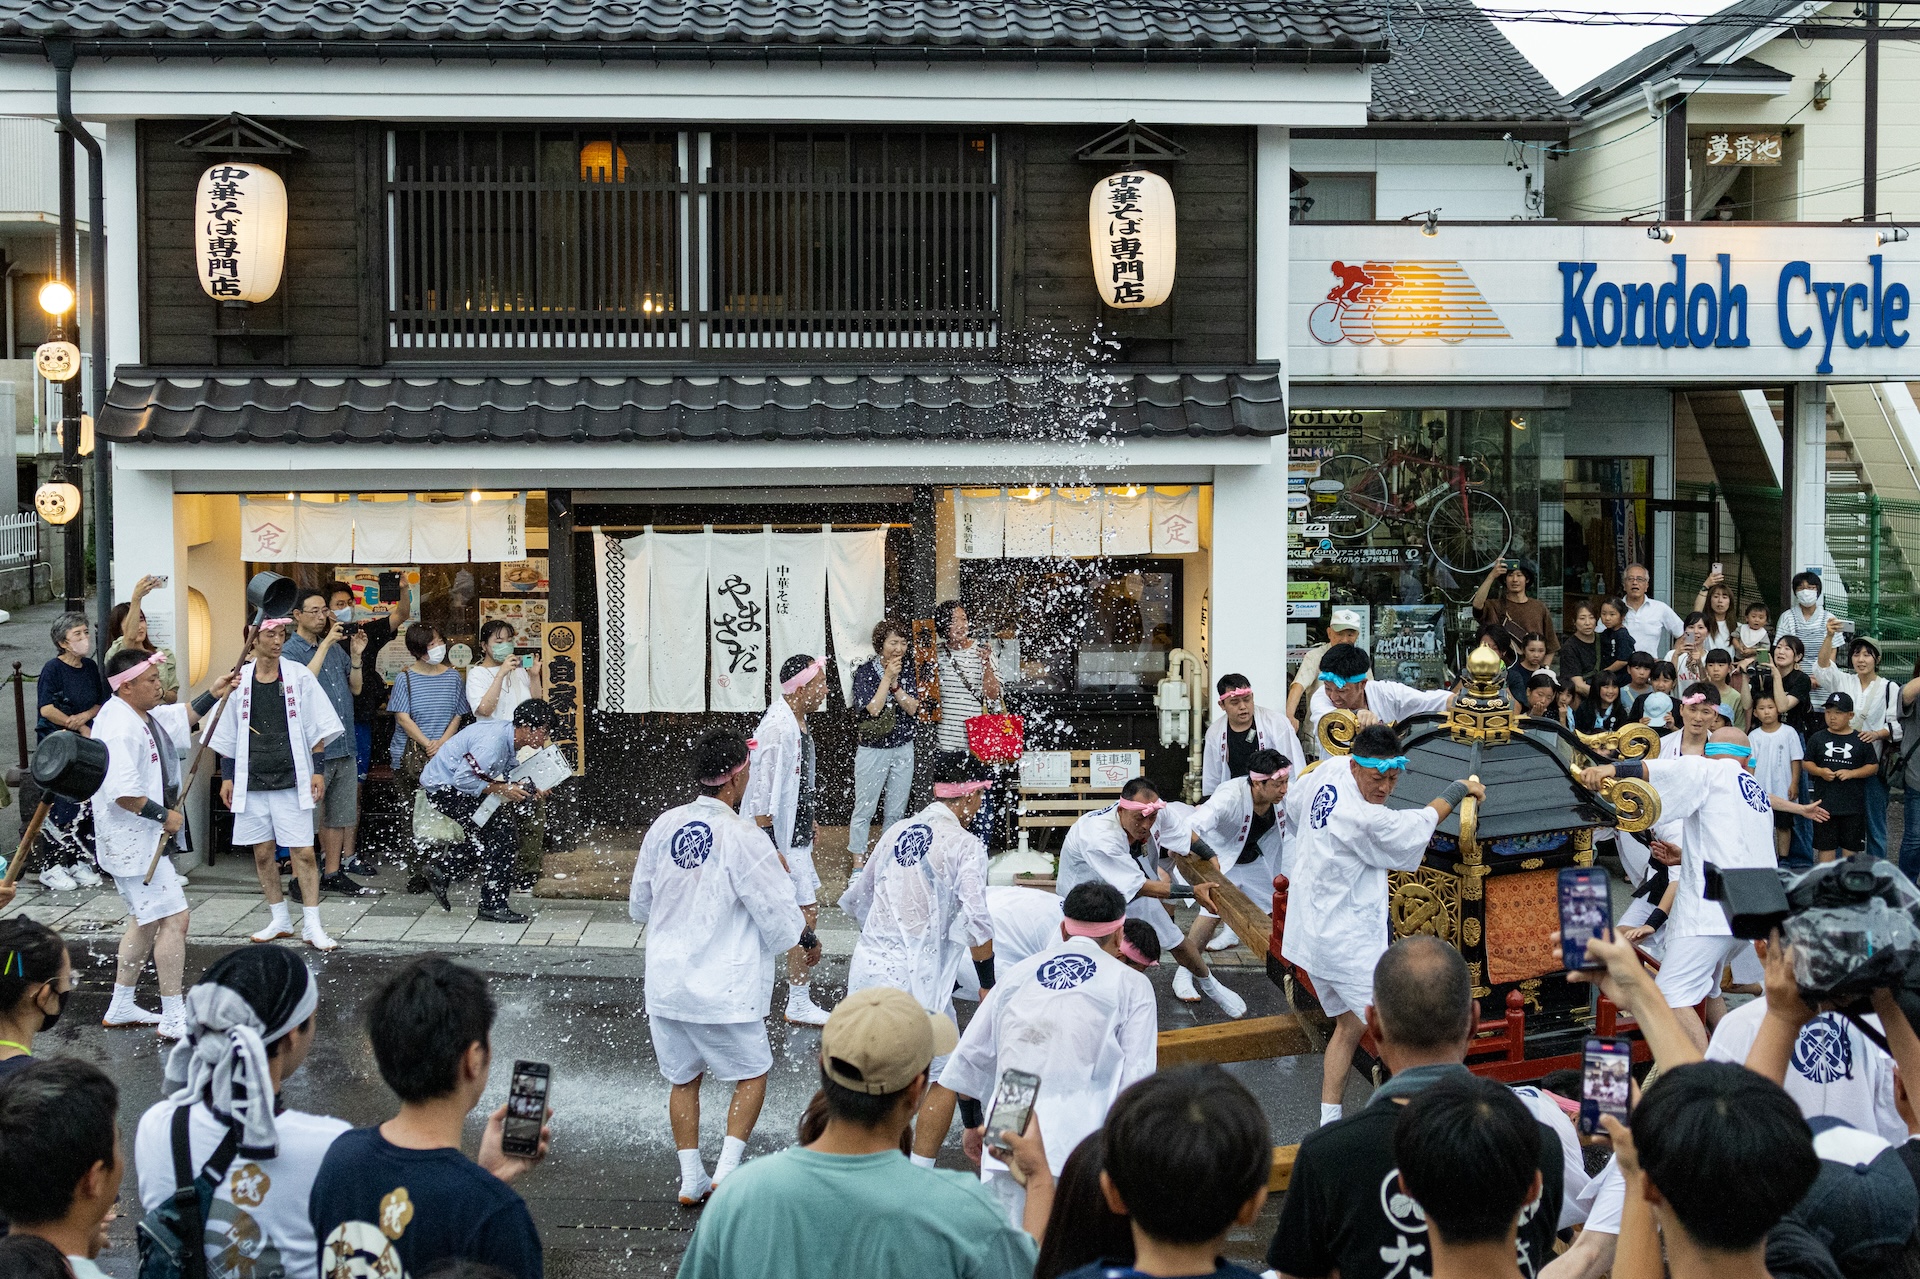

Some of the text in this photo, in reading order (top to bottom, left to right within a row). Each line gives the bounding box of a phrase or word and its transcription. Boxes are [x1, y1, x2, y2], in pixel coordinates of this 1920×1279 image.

[1706, 133, 1782, 164] 夢番地
[207, 166, 250, 297] 中華そば専門店
[1107, 174, 1146, 304] 中華そば専門店
[1555, 253, 1911, 375] Kondoh Cycle
[507, 514, 519, 556] 信州小諸
[963, 512, 974, 554] 自家製麺
[1287, 550, 1313, 558] AKLEY
[776, 564, 790, 615] 中華そば
[1095, 753, 1133, 766] 駐車場
